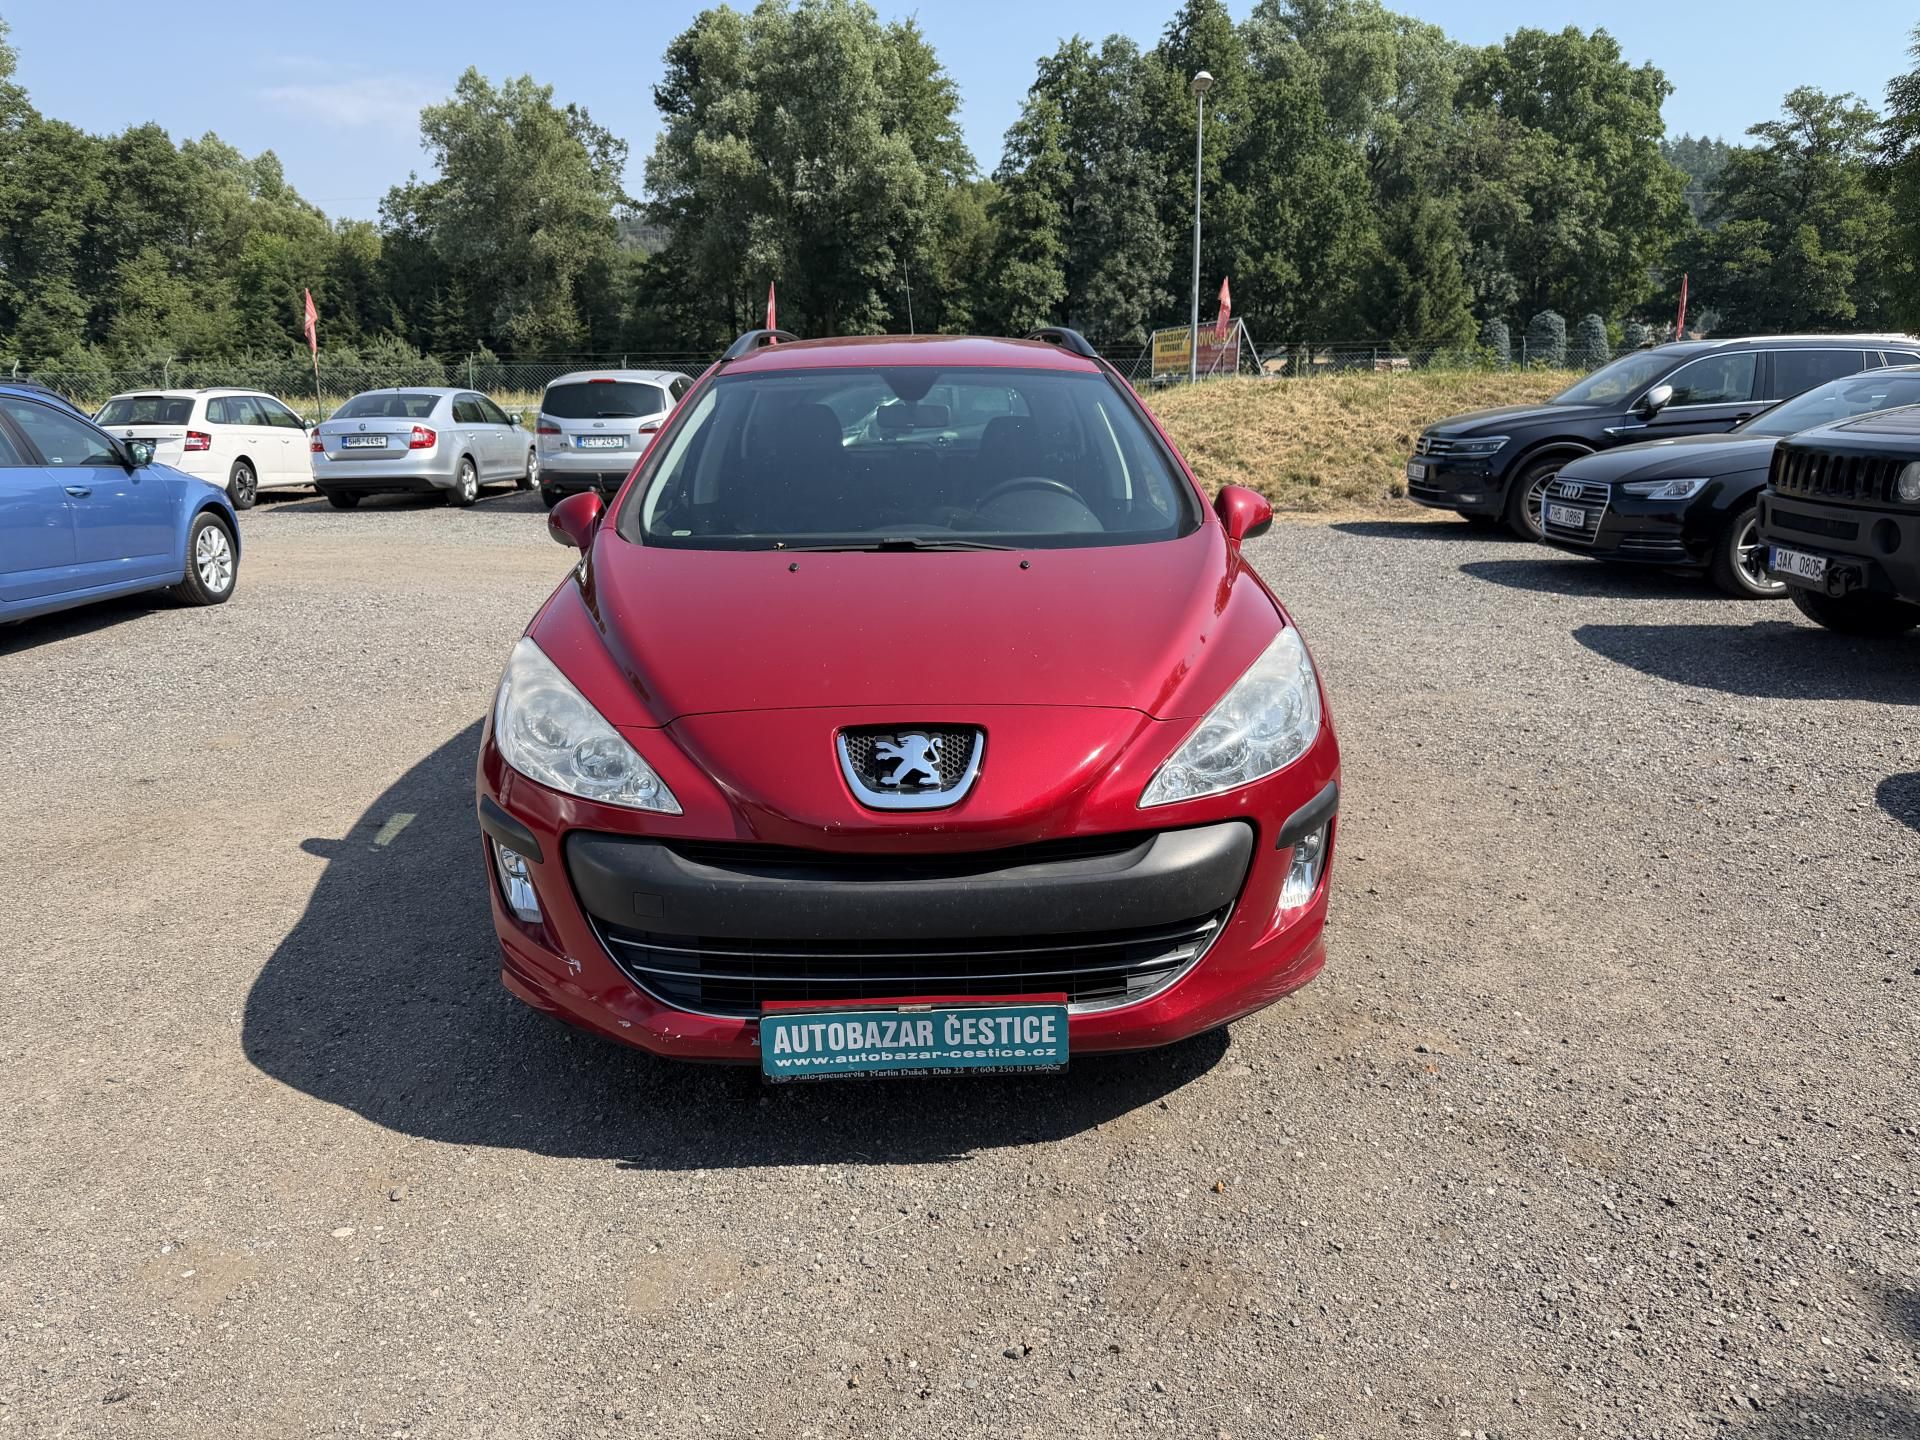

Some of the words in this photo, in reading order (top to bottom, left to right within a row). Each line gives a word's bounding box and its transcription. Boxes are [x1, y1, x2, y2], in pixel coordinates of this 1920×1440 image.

[1565, 510, 1582, 524] 0886
[1777, 551, 1794, 569] 3AK
[1799, 556, 1822, 577] 0805
[773, 1020, 934, 1054] AUTOBAZAR
[944, 1014, 1057, 1046] ČESTICE
[775, 1048, 1057, 1067] www.autobazar-cestice.cz
[870, 1069, 899, 1078] Martin
[933, 1067, 951, 1076] Dub
